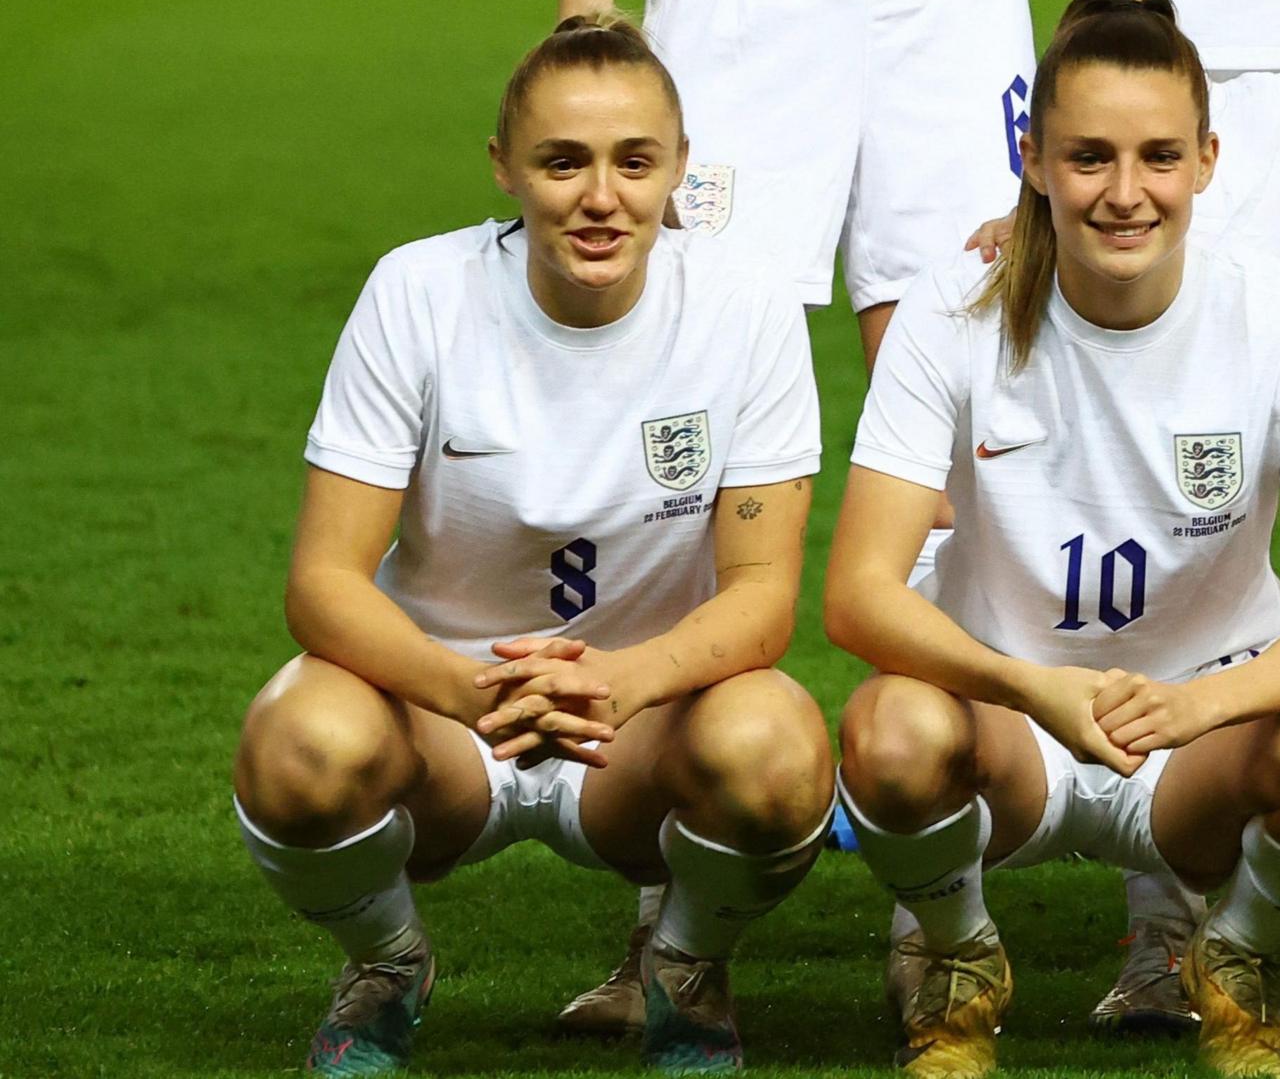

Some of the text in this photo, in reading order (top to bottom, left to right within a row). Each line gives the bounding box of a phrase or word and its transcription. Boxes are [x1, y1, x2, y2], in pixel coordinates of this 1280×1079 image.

[663, 494, 702, 509] BELGIUM
[644, 513, 653, 523] 22
[655, 505, 701, 520] FEBRUARY
[1192, 513, 1231, 526] BELGIUM
[1173, 527, 1183, 536] 22
[1185, 523, 1229, 537] FEBRUARY
[550, 537, 597, 622] 8
[1053, 533, 1147, 632] 10
